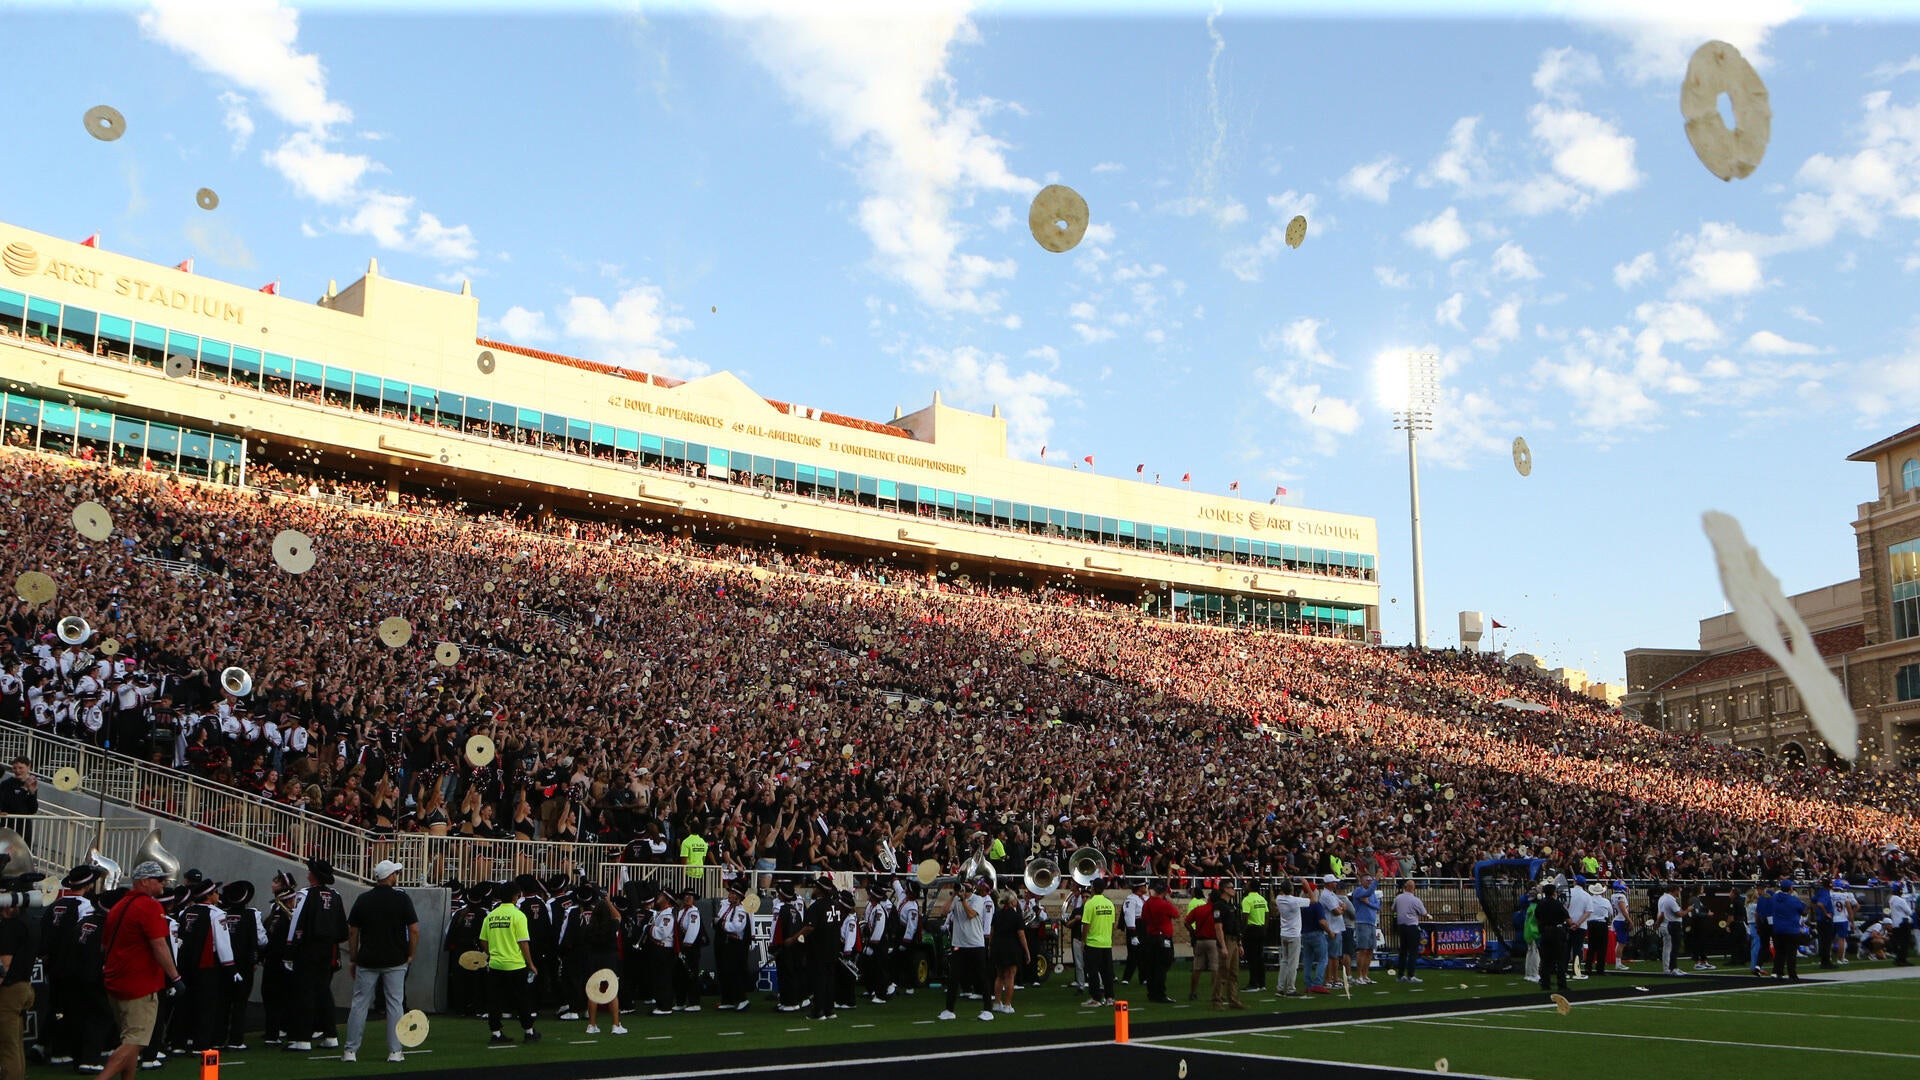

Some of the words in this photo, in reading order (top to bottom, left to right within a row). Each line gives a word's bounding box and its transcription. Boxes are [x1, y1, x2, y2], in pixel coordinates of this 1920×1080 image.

[43, 259, 104, 289] AT&T
[115, 275, 245, 325] STADIUM
[608, 395, 621, 407] 42
[624, 397, 653, 415] BOWL
[655, 405, 724, 429] APPEARANCES
[746, 422, 821, 449] ALL-AMERICANS
[841, 443, 896, 463] CONFERENCE
[897, 454, 967, 475] CHAMPIONSHIPS
[1197, 505, 1244, 525] JONES
[1266, 516, 1293, 531] AT&T
[1297, 518, 1359, 541] STADIUM
[1836, 901, 1844, 912] 9
[1437, 929, 1471, 943] KANSAS
